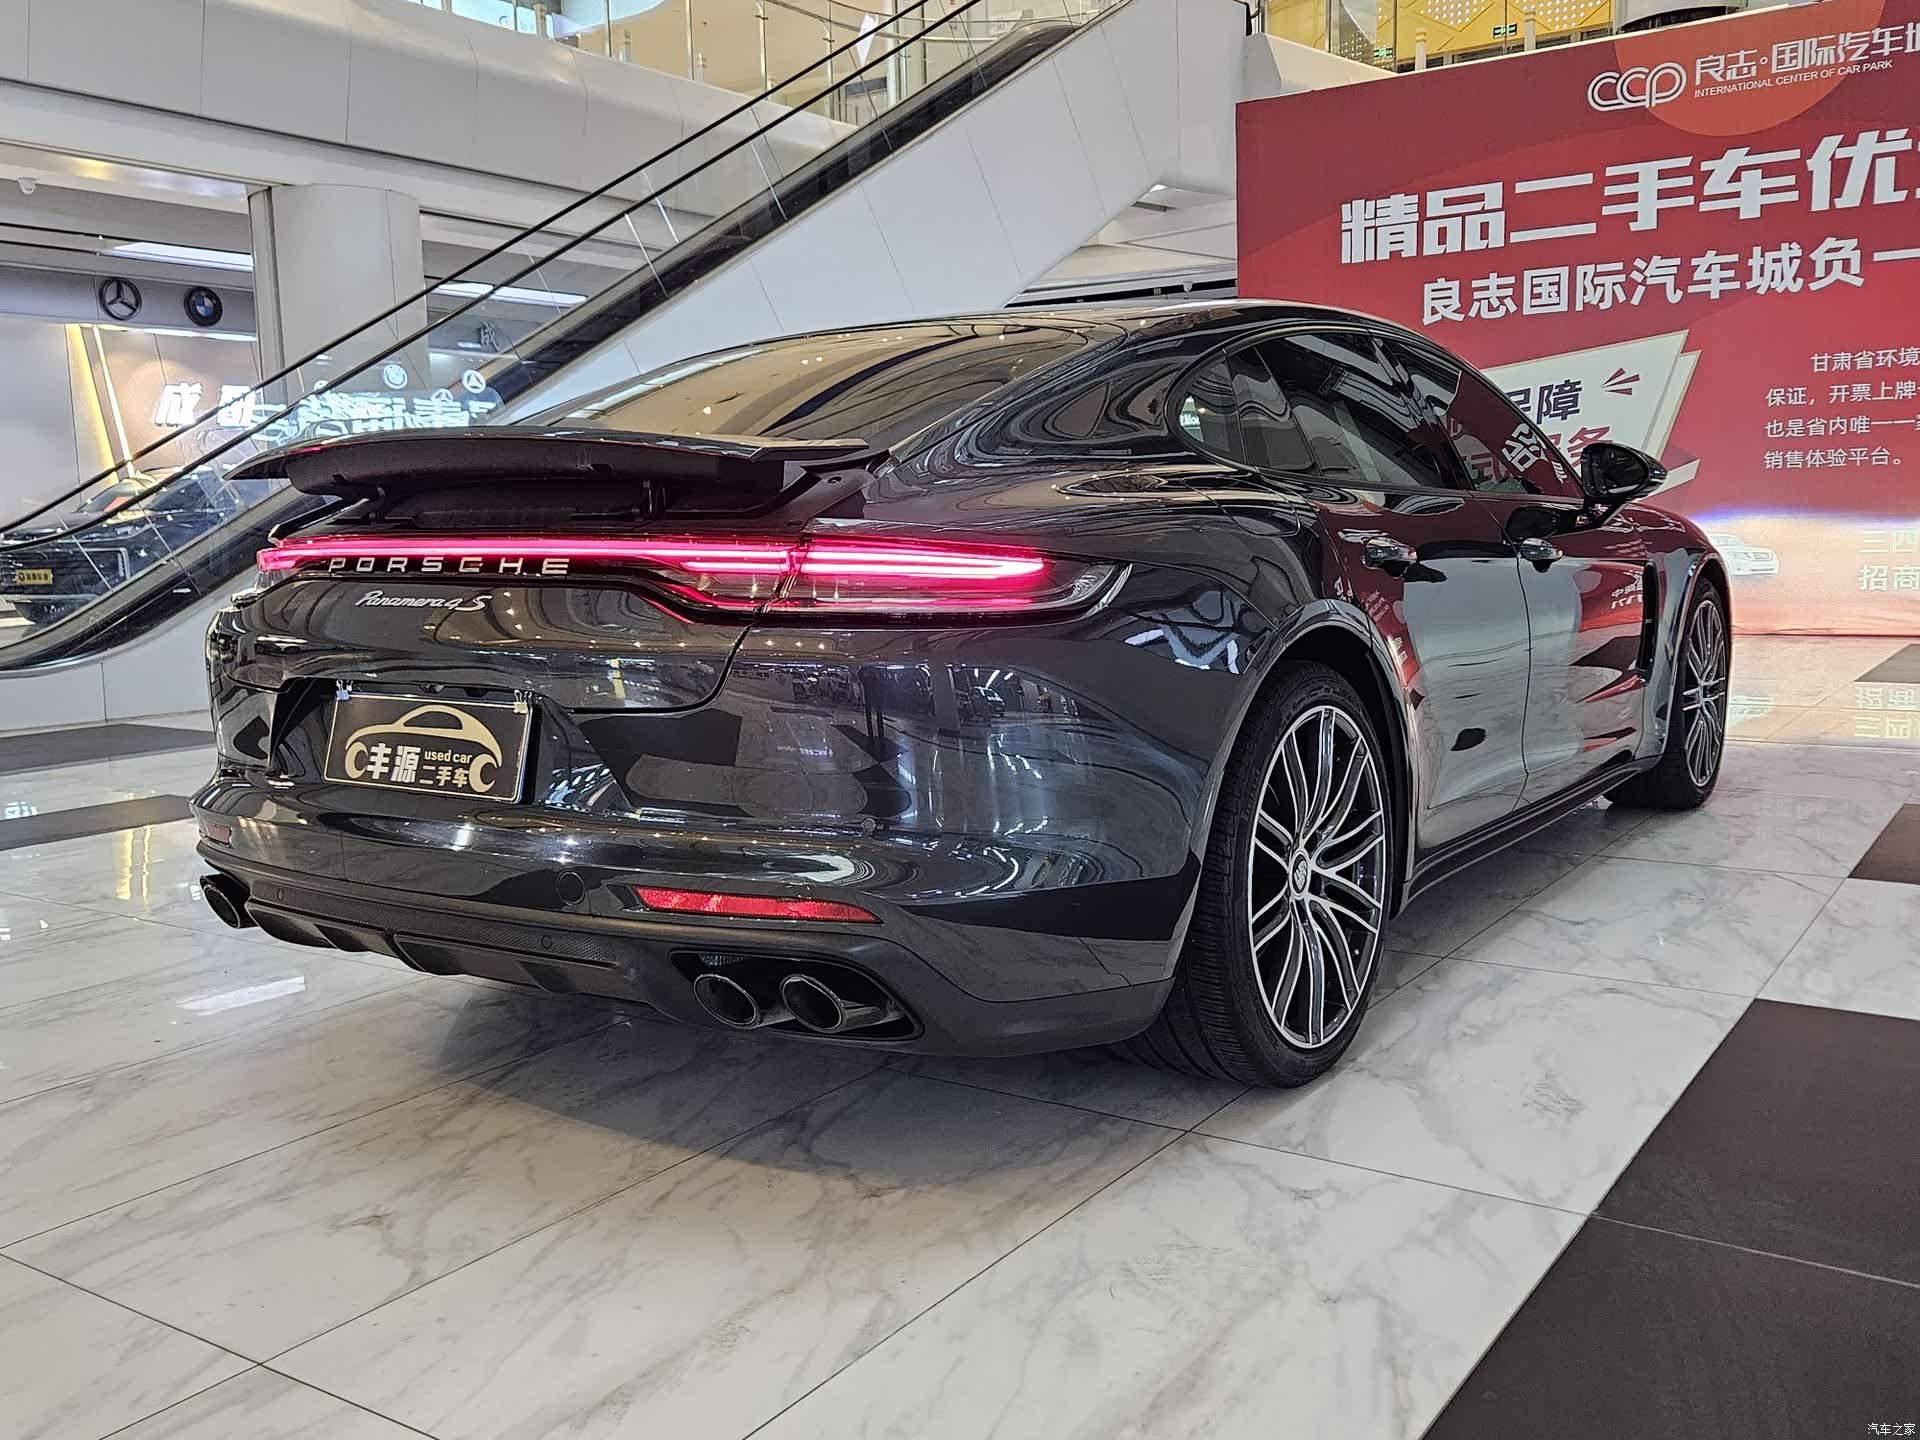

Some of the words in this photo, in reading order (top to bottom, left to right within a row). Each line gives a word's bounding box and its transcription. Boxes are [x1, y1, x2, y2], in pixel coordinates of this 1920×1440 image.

[1694, 78, 1774, 99] INTERNATIONAL
[1775, 71, 1818, 87] CENTER
[1820, 67, 1836, 79] OF
[1837, 65, 1861, 76] CAR
[1862, 59, 1894, 73] PARK
[1341, 128, 1920, 264] 精品二手车优
[1422, 236, 1920, 326] 良志国际汽车城负一
[1810, 346, 1920, 373] 甘肃省环境
[1764, 414, 1920, 438] 也是省内唯一一
[1763, 446, 1902, 470] 销售体验平台。
[328, 556, 570, 575] PORSCHE
[355, 589, 445, 609] Panamera
[366, 742, 422, 784] 丰源
[424, 749, 451, 763] used
[453, 753, 473, 765] car
[419, 764, 470, 788] 二手车
